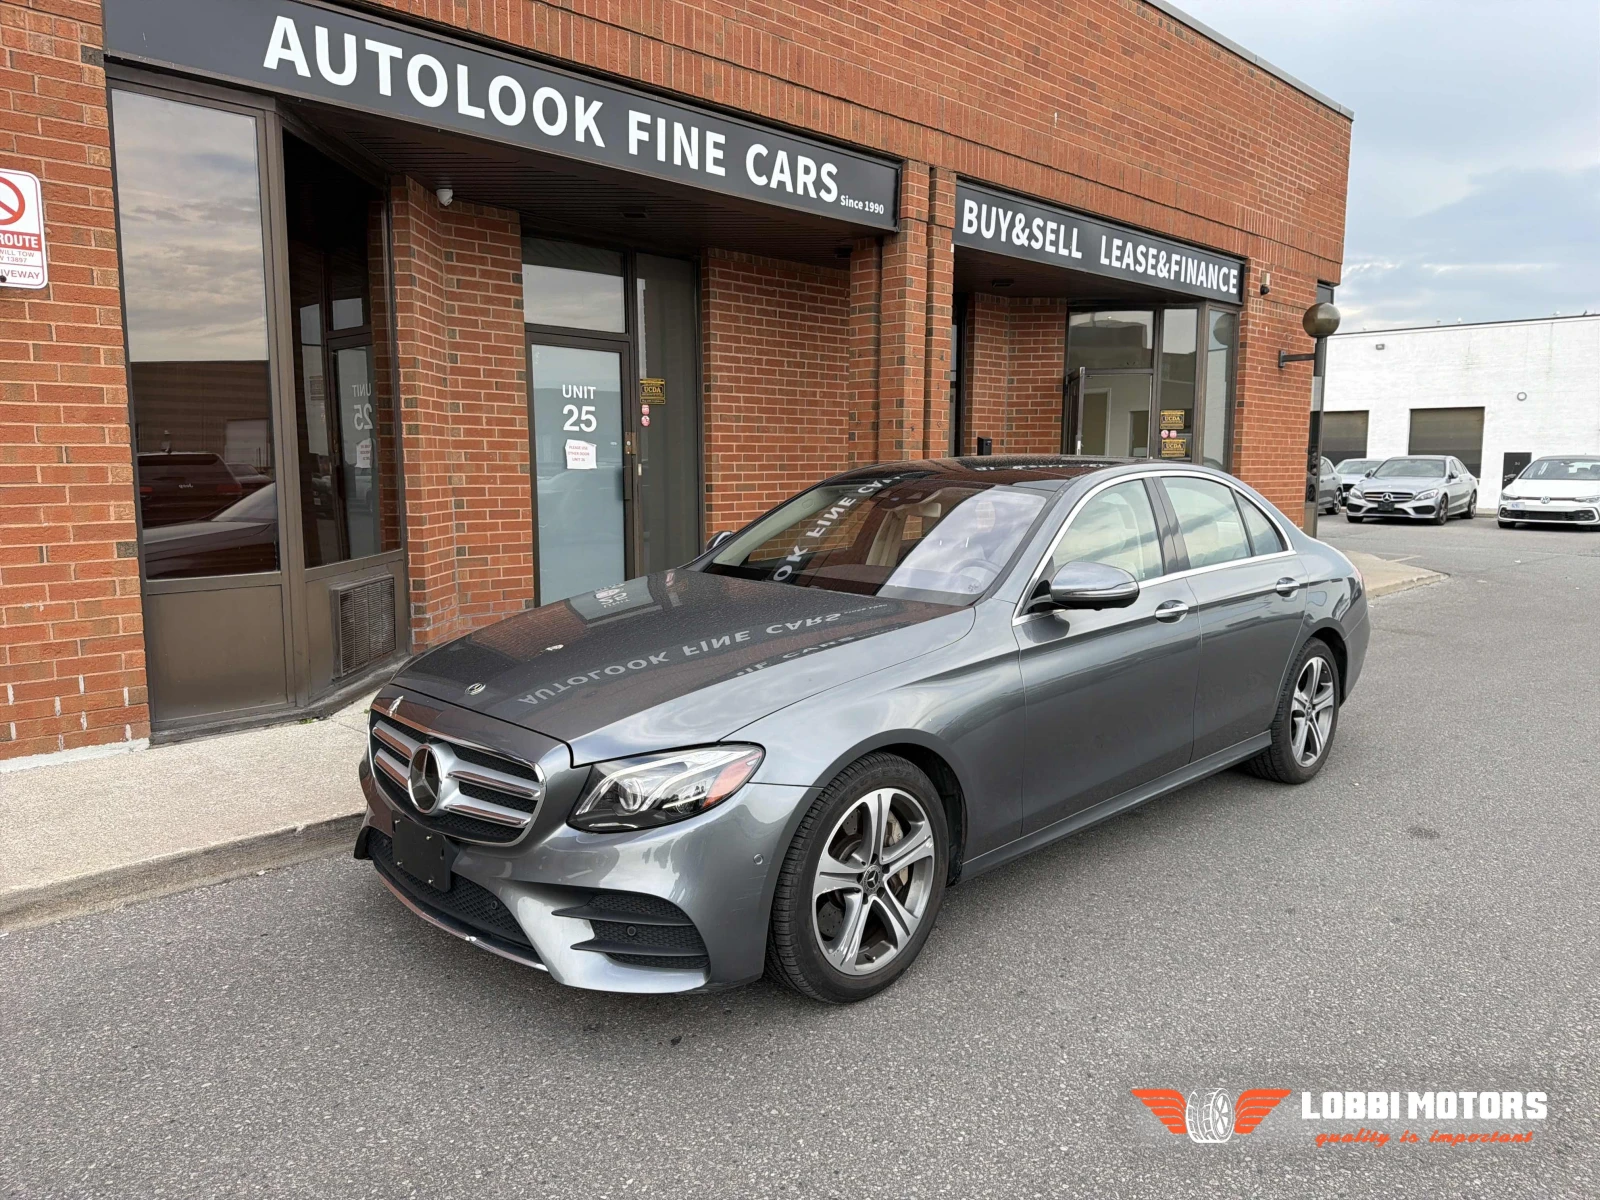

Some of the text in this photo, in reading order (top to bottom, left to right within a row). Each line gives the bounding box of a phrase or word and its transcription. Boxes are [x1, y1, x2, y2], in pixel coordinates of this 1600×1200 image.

[263, 15, 838, 203] AUTOLOOK FINE CARS
[840, 194, 885, 215] Since 1990
[962, 198, 1239, 295] BUY&SELL LEASE&FINANCE
[562, 384, 597, 400] UNIT
[562, 404, 598, 433] 25
